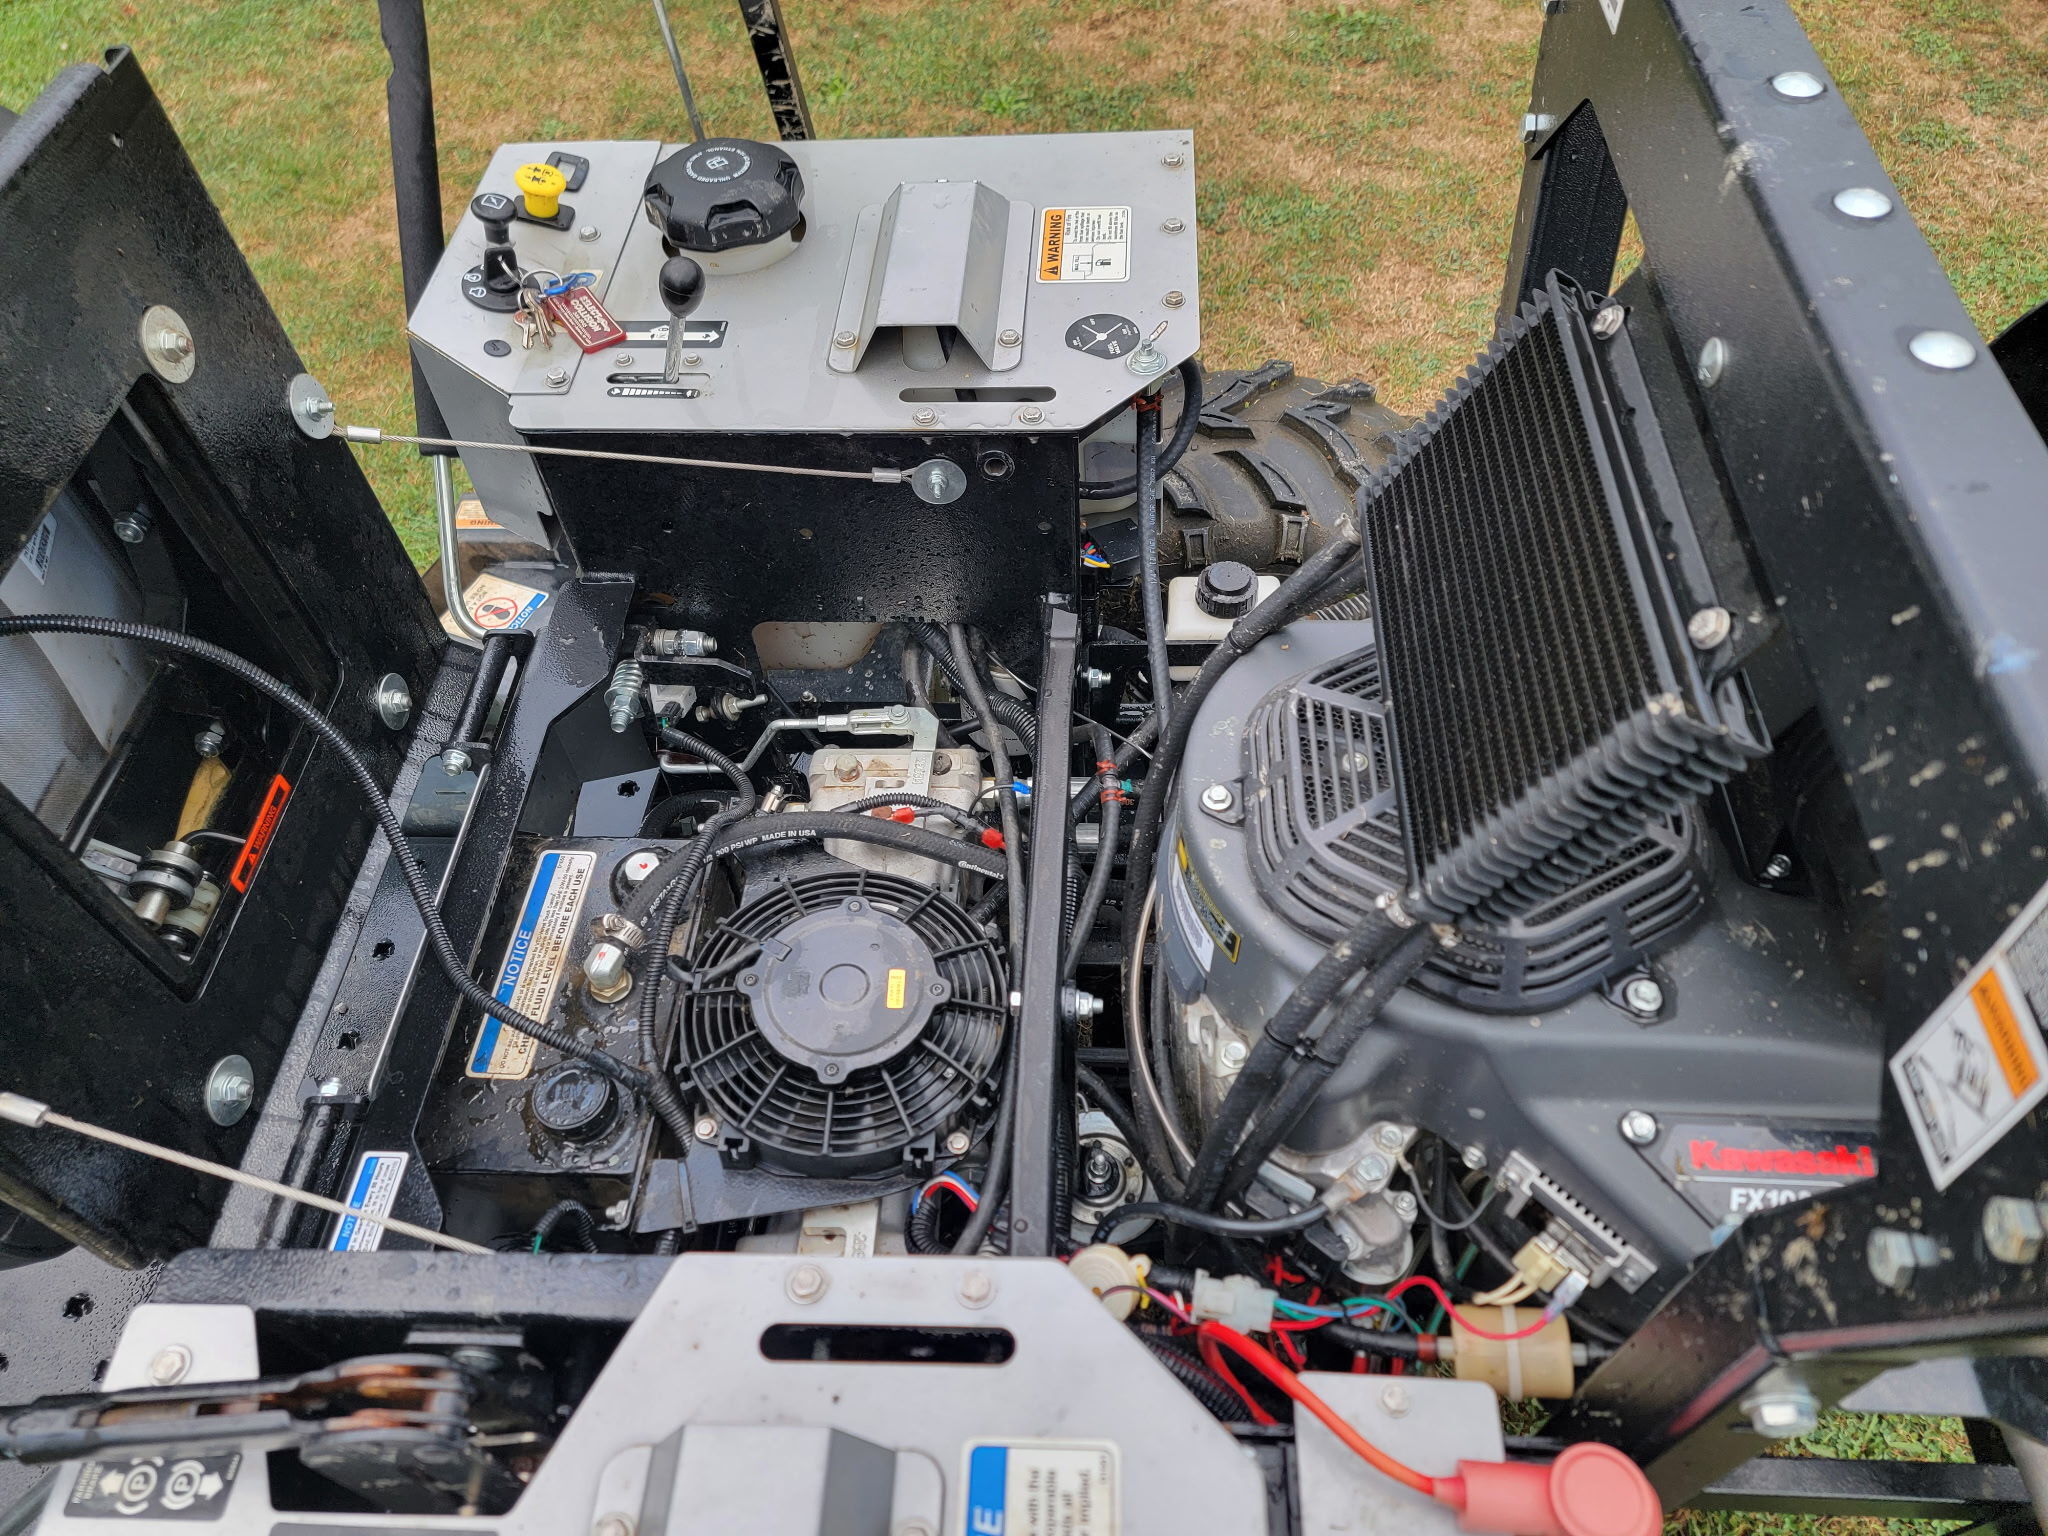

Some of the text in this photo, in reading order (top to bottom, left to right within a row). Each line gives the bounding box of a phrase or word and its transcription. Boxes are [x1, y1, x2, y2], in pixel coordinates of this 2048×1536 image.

[1046, 214, 1062, 262] WARNING
[570, 299, 601, 333] COLLISION
[579, 295, 603, 319] SELECT
[509, 606, 533, 629] NOTIC
[254, 806, 278, 850] WARNING
[715, 846, 730, 857] 300
[730, 841, 744, 851] PSI
[744, 837, 759, 846] WP
[761, 831, 786, 842] MADE
[798, 829, 817, 837] USA
[957, 860, 999, 879] Continental
[501, 929, 533, 985] NOTICE
[518, 867, 585, 1054] CHE FLUID LEVEL BEFORE EACH USE
[502, 1048, 510, 1059] NOT
[373, 1162, 385, 1179] Hours
[1689, 1140, 1875, 1177] Kawasaki
[341, 1200, 361, 1237] NOTE
